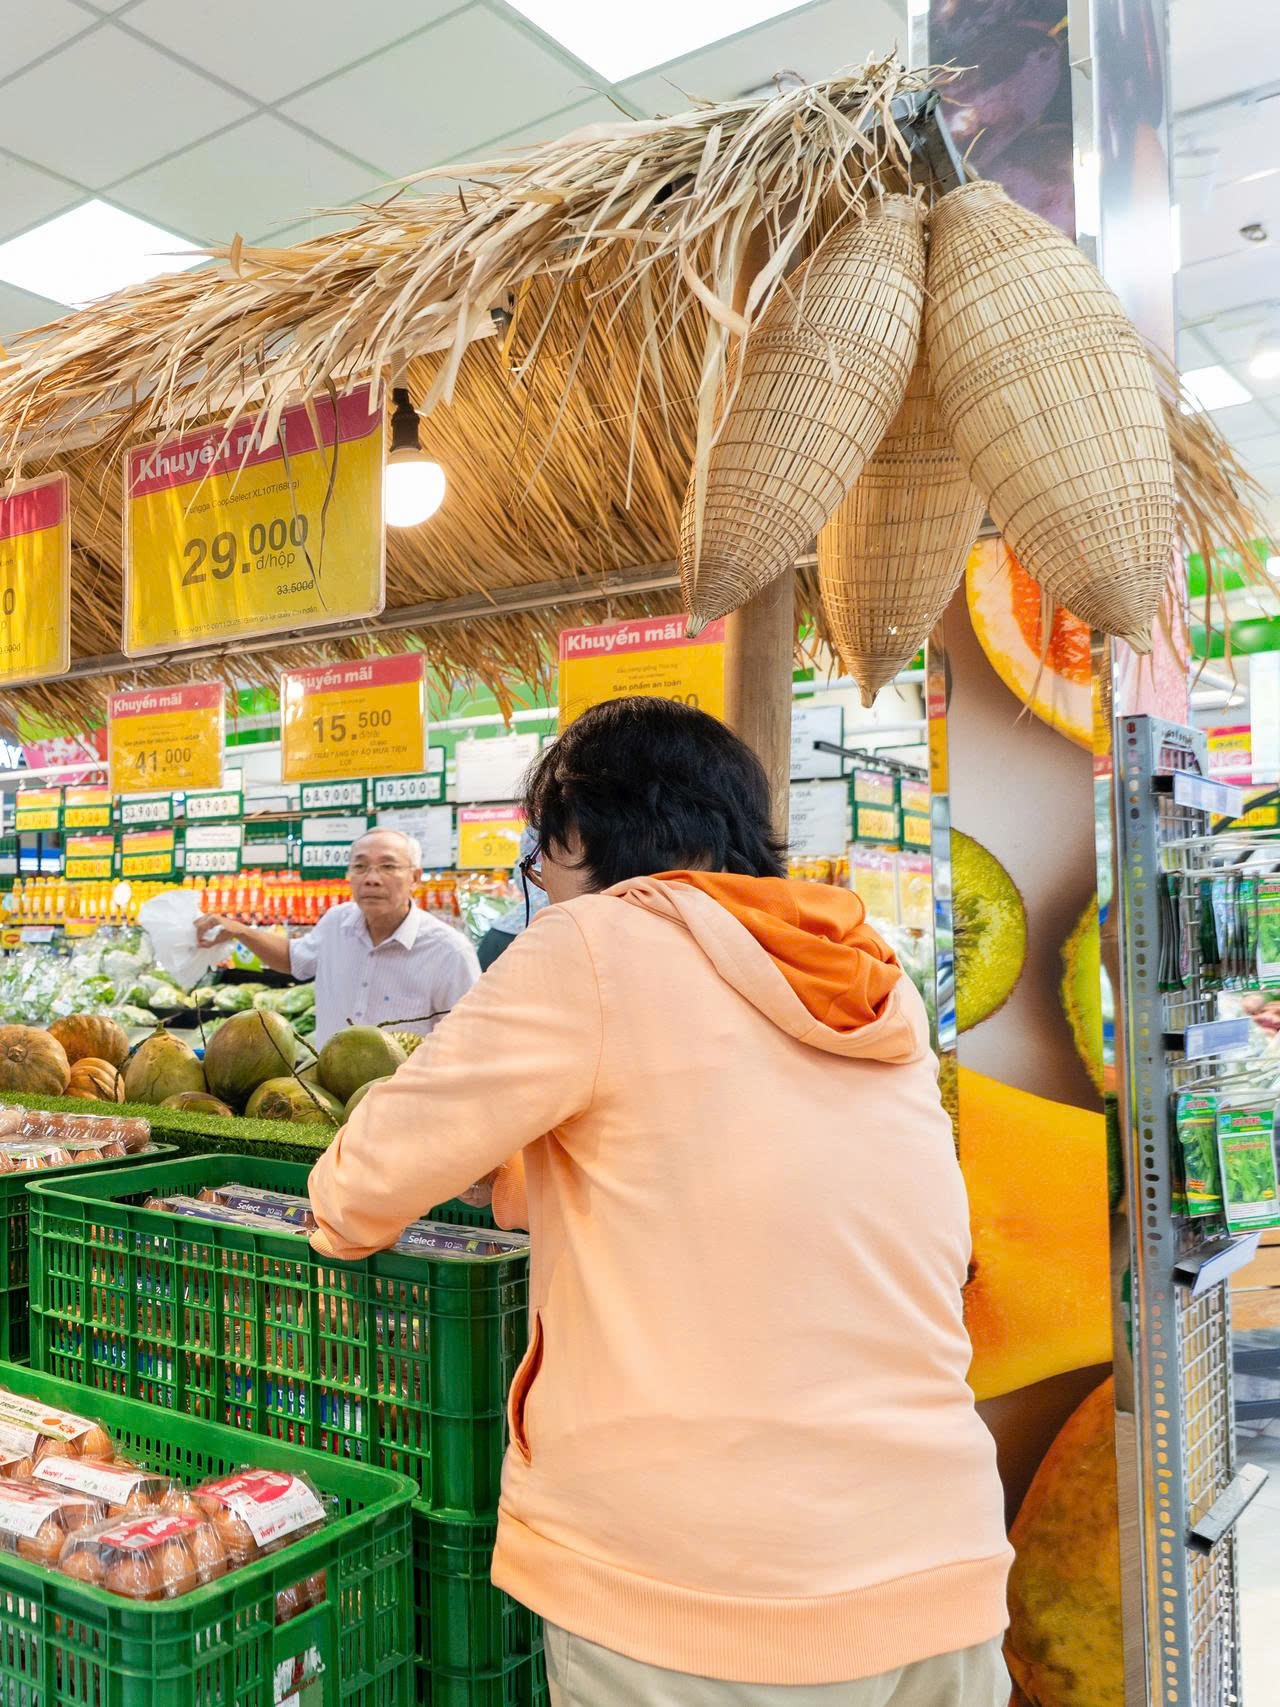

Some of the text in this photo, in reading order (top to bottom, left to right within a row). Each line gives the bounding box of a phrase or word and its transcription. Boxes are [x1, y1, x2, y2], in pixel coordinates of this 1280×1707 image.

[237, 418, 287, 454] mi
[181, 513, 309, 587] 29.000
[256, 550, 296, 571] đ/hộp
[568, 622, 683, 651] Khuyến mãi
[344, 666, 373, 684] mãi
[114, 692, 182, 713] Khuyến mãi
[313, 709, 392, 743] 15.500
[135, 747, 191, 774] 41.000
[236, 1202, 275, 1215] Select 10
[408, 1234, 453, 1249] Select 10
